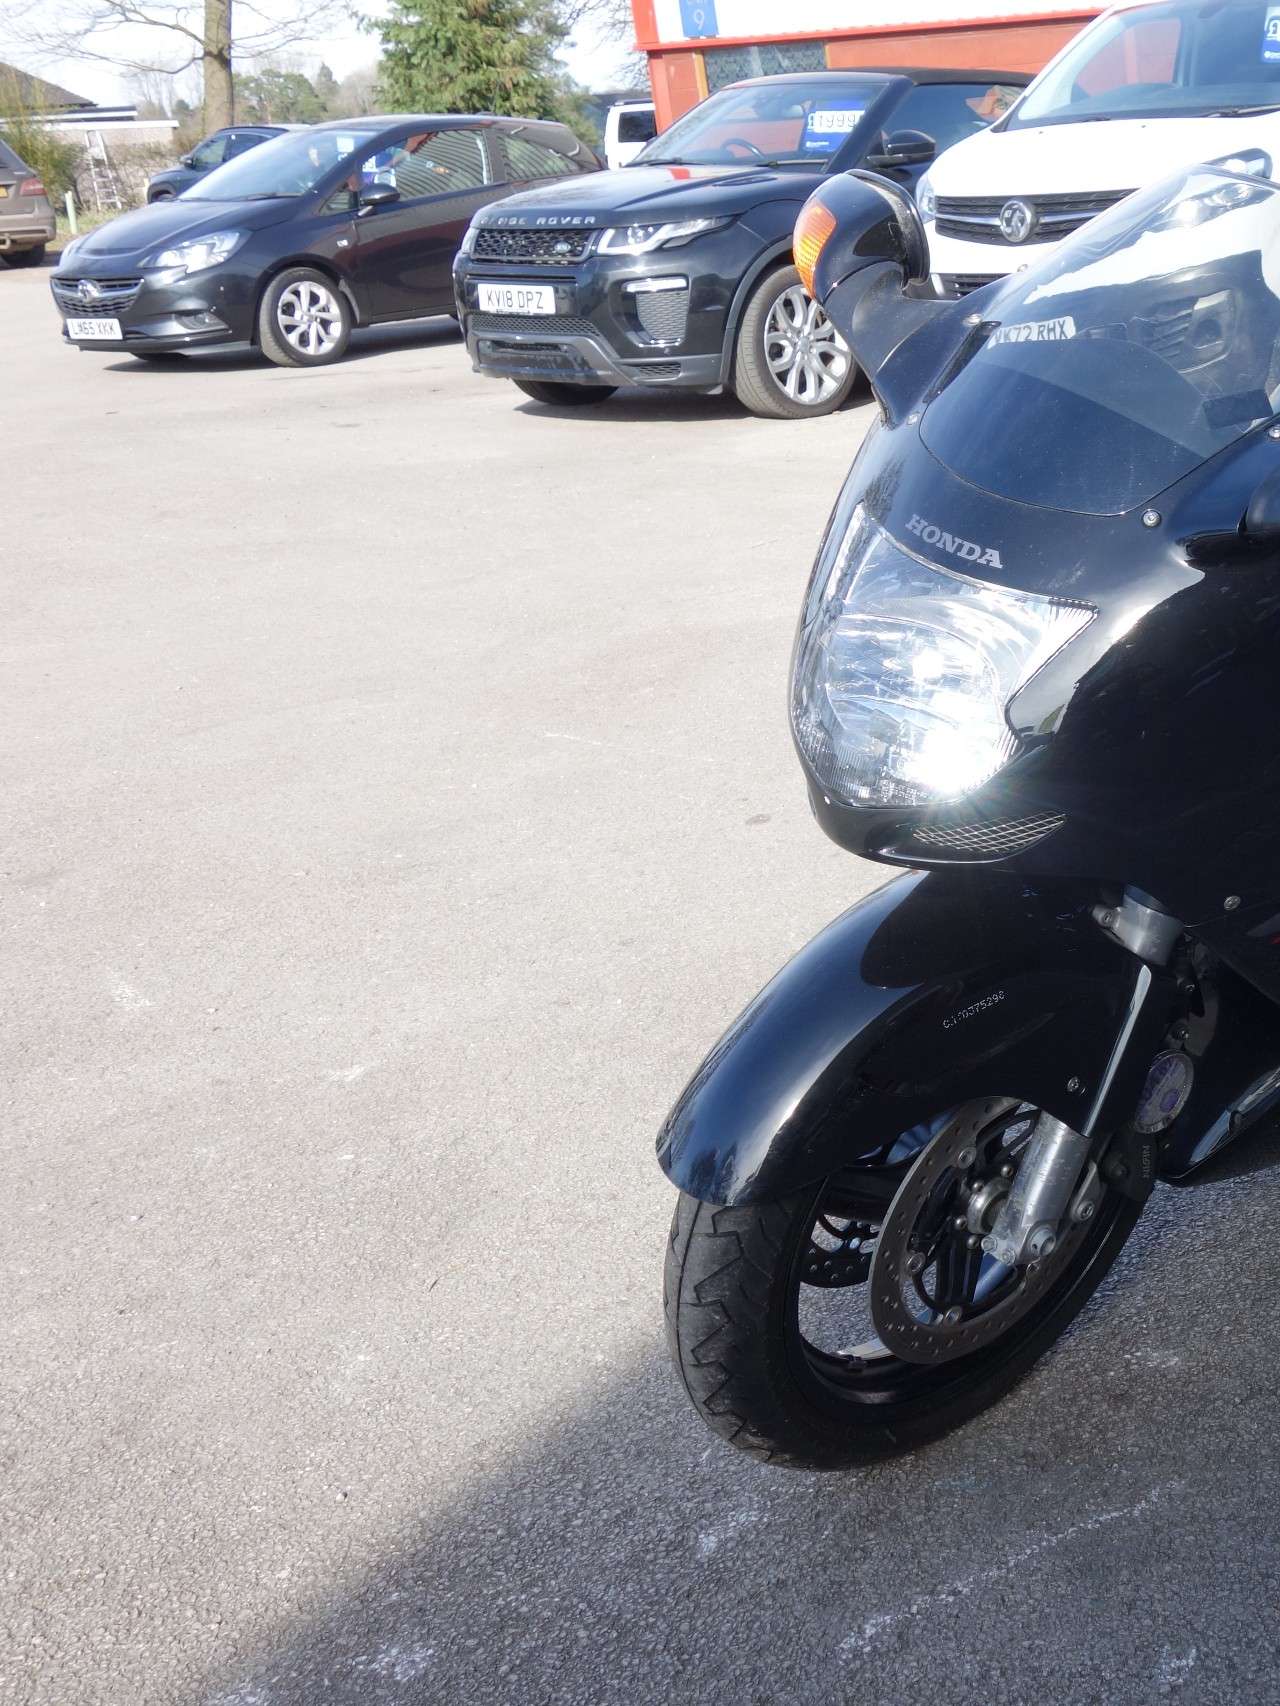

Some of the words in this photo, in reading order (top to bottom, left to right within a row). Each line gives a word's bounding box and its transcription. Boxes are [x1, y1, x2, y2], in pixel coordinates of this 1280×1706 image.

[693, 9, 704, 31] 9
[536, 216, 596, 225] ROVER
[487, 290, 513, 308] KV18
[517, 291, 543, 310] DPZ
[1037, 319, 1069, 340] RHX
[905, 513, 1003, 569] HONDA
